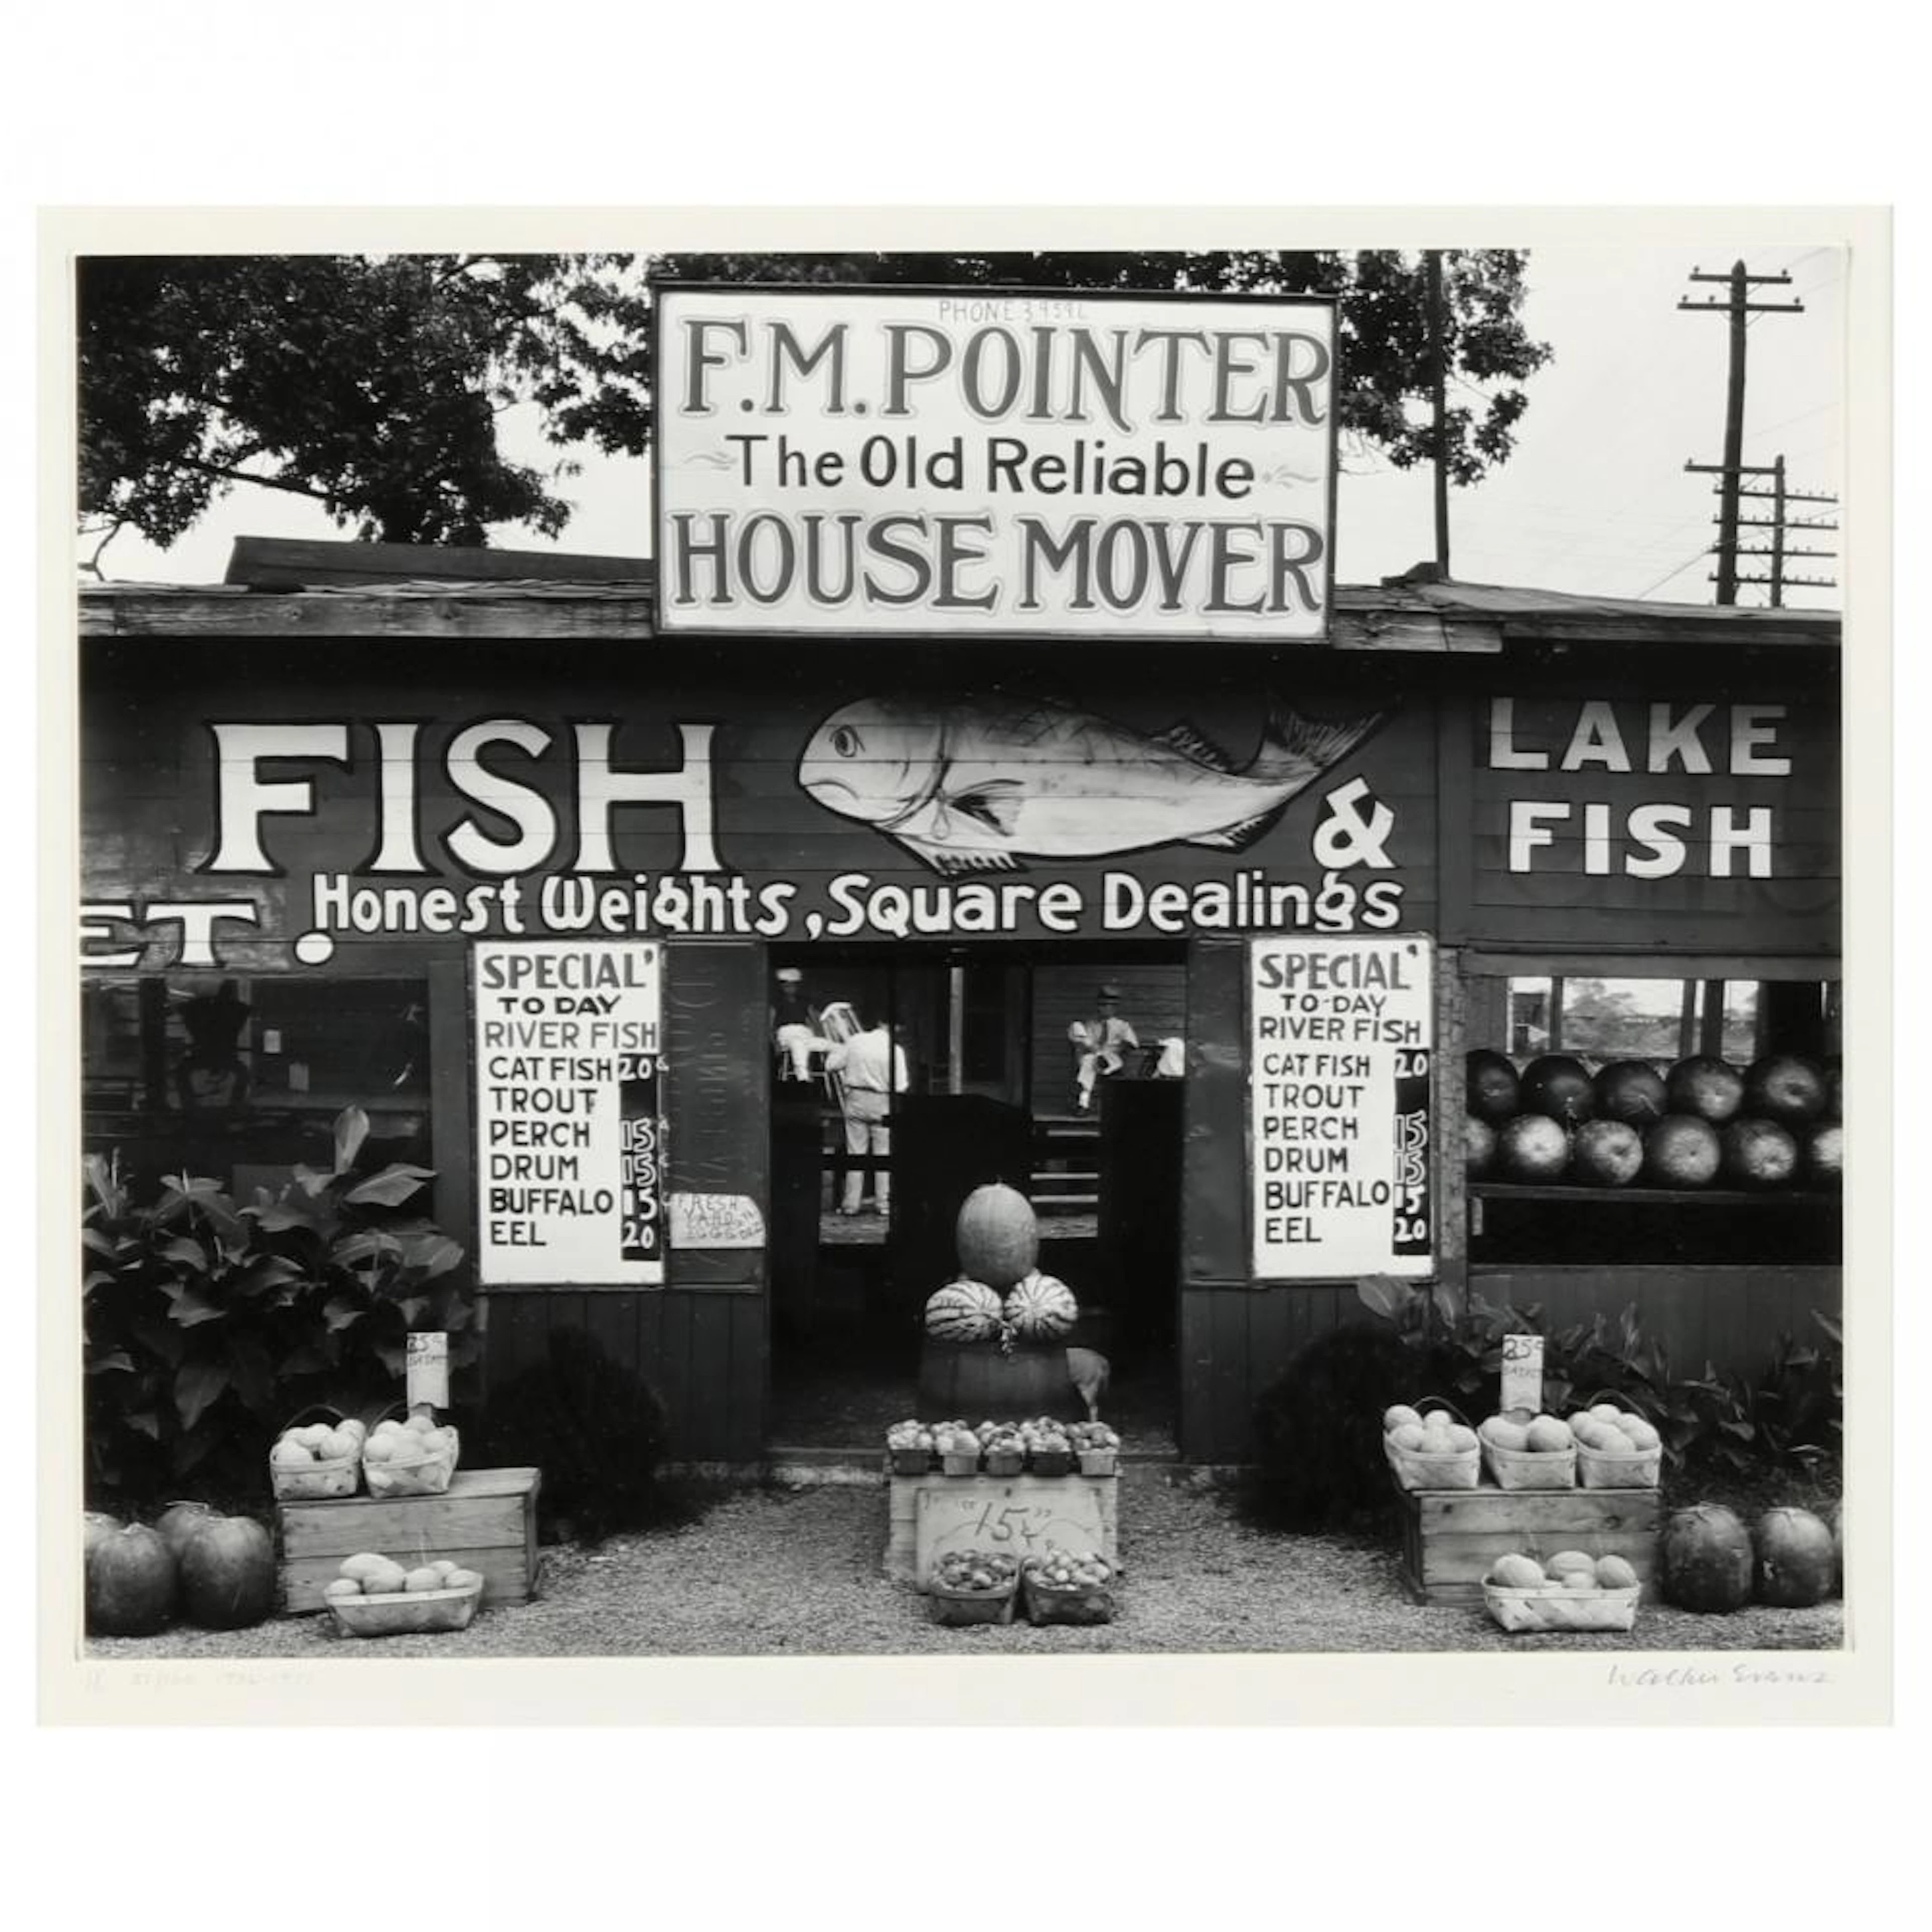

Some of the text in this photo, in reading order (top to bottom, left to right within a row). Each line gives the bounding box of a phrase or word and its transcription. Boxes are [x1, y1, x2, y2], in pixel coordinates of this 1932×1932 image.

[939, 300, 1014, 323] PHONE
[880, 322, 1332, 433] POINTER
[725, 434, 1256, 499] The Old Reliable
[670, 512, 1325, 613] HOUSE MOVER
[1489, 696, 1792, 776] LAKE
[206, 717, 1397, 873] FISH &
[1509, 800, 1772, 879] FISH
[313, 873, 525, 934] Honest
[827, 873, 1082, 938] Square
[1103, 870, 1404, 933] Dealings
[485, 1021, 659, 1050] RIVER FISH
[1259, 1017, 1421, 1044] RIVER FISH
[1394, 1053, 1428, 1079] 20
[488, 1087, 598, 1115] TROUT
[1263, 1083, 1365, 1109] TROUT
[489, 1120, 591, 1148] PERCH
[1263, 1109, 1428, 1152] PERCH 15
[489, 1155, 579, 1181] DRUM
[1264, 1148, 1426, 1185] DRUM 15
[489, 1187, 614, 1217] BUFFALO
[1265, 1180, 1426, 1215] BUFFALO 15
[490, 1221, 547, 1247] EEL
[1265, 1216, 1427, 1243] EEL 20
